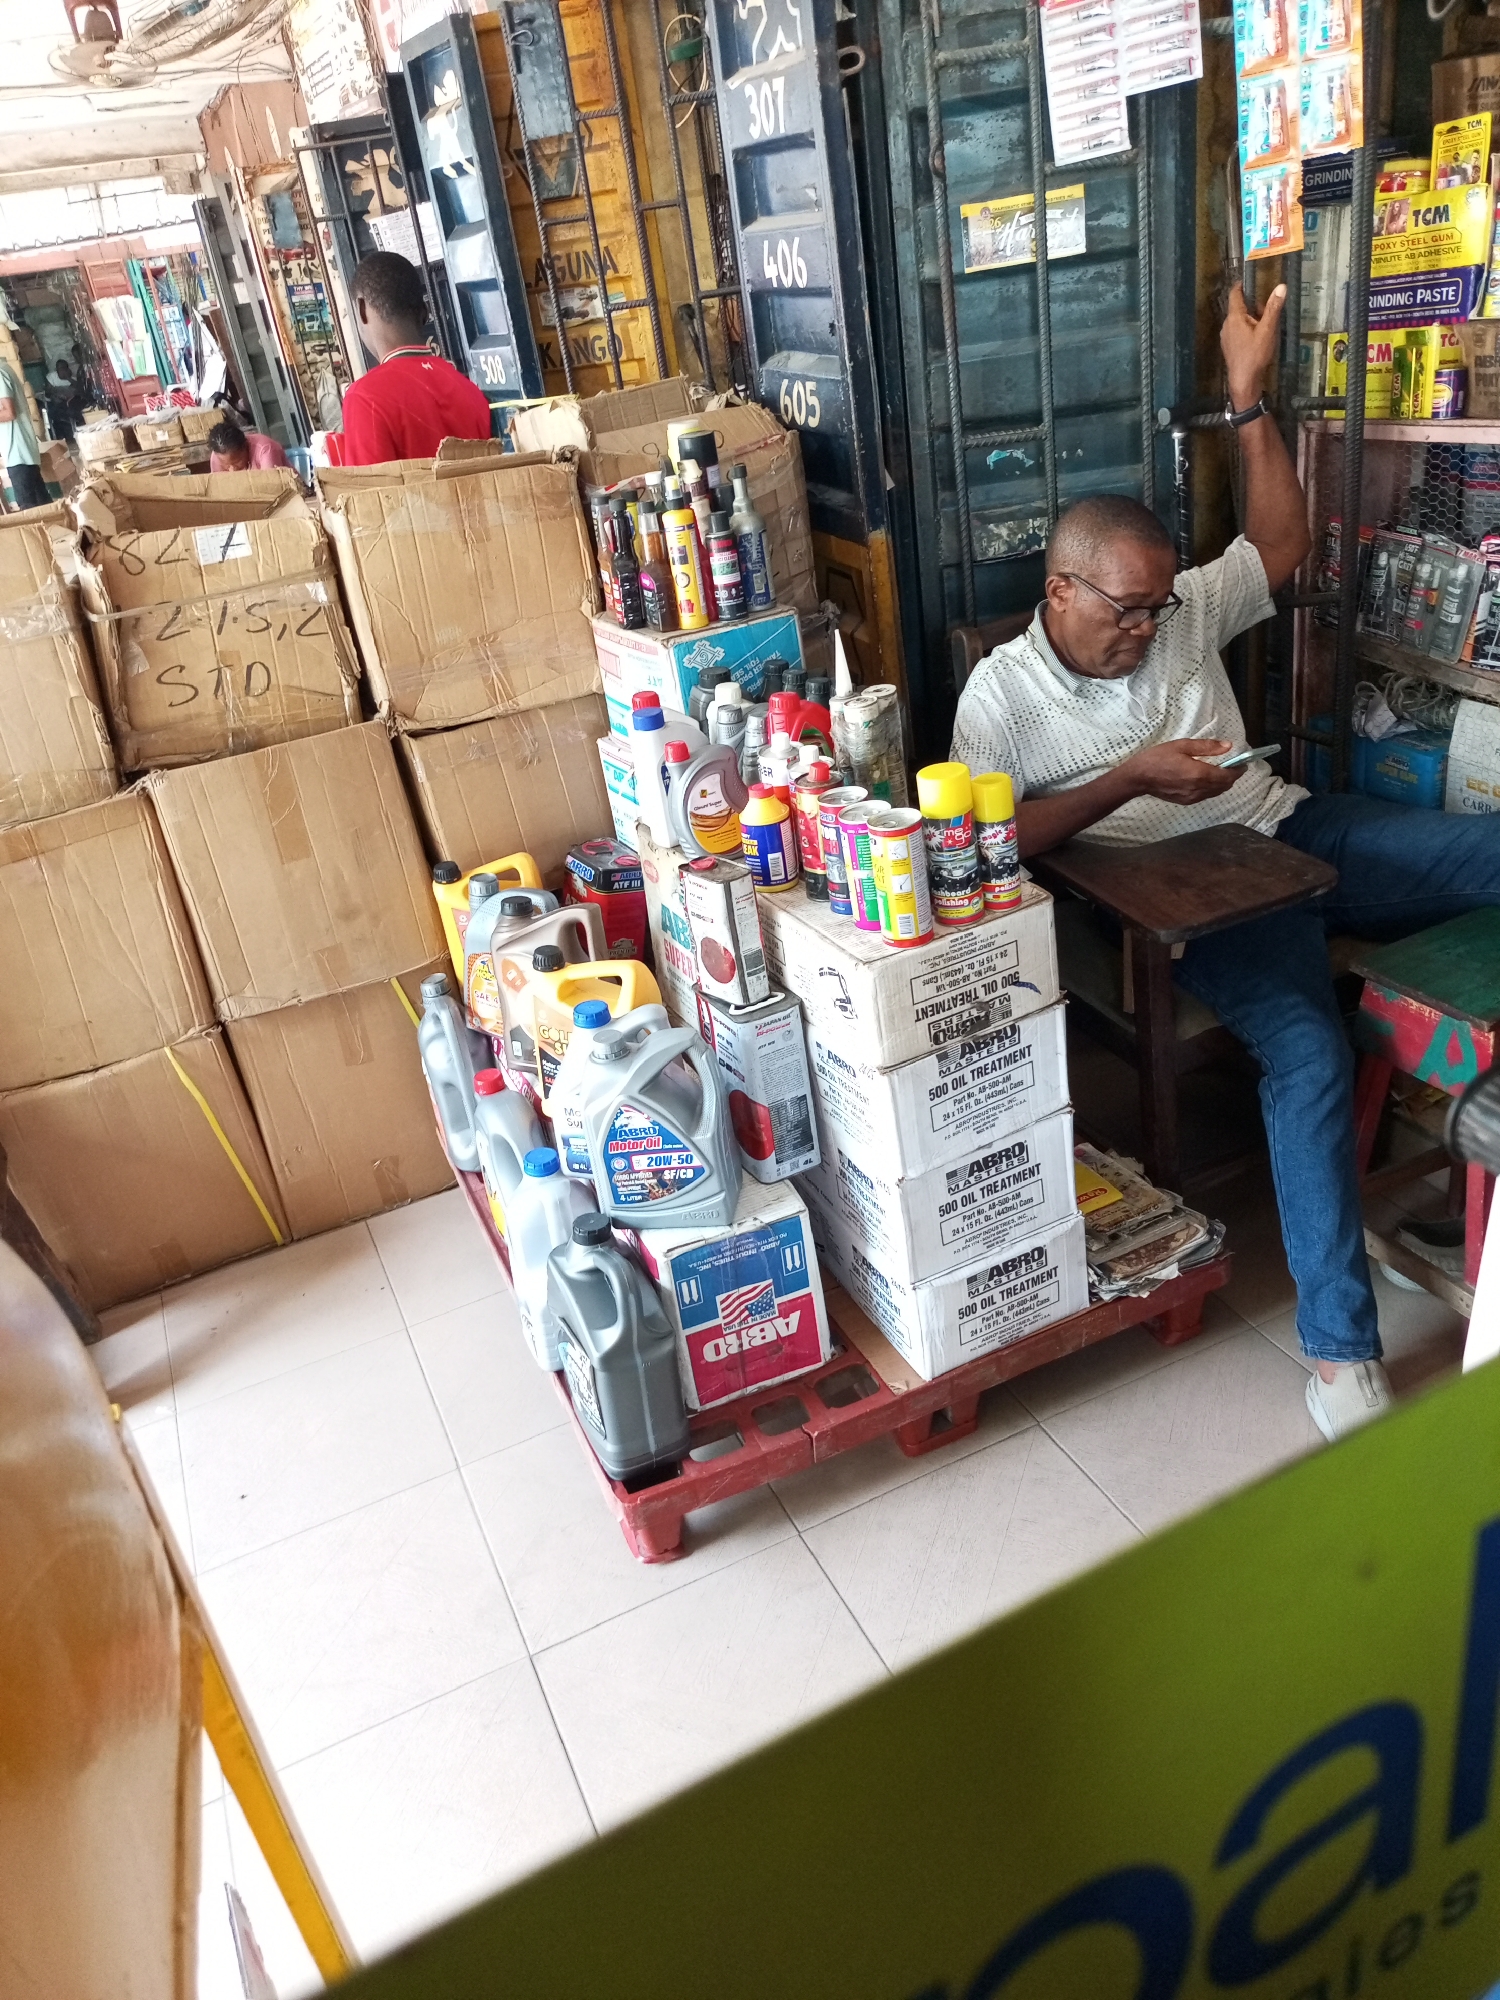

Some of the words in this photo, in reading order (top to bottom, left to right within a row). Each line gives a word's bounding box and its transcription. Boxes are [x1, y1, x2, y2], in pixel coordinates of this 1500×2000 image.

[744, 76, 785, 140] 307
[1467, 119, 1482, 129] TCM
[1305, 168, 1353, 187] GRINDIN
[1412, 204, 1451, 228] TCM
[1400, 237, 1428, 248] STEEL
[1431, 233, 1454, 243] GUM
[1404, 252, 1416, 260] AB
[1417, 246, 1462, 259] ADHESIVE
[525, 245, 619, 289] AGUNA
[763, 237, 808, 288] 406
[1369, 291, 1414, 309] RINDING
[1416, 286, 1457, 304] PASTE
[1366, 343, 1393, 364] CM
[479, 355, 507, 385] 508
[780, 379, 821, 428] 605
[156, 661, 272, 707] STD
[731, 665, 747, 682] SEA
[567, 858, 595, 882] ABRO
[613, 880, 630, 889] ATF
[934, 898, 970, 907] polishing
[995, 882, 1021, 893] polishin
[661, 903, 690, 950] AB
[664, 938, 695, 982] SUPER
[983, 965, 997, 978] Part
[922, 973, 938, 987] Cans
[980, 979, 999, 998] OIL
[1001, 971, 1020, 990] 500
[914, 986, 980, 1023] TREATMENT
[938, 1037, 1018, 1077] MASTERS
[959, 1022, 1019, 1060] ABRO
[929, 1083, 948, 1101] 500
[951, 1074, 968, 1091] OIL
[970, 1044, 1033, 1081] TREATMENT
[943, 1112, 951, 1122] 24
[957, 1106, 964, 1116] 15
[1009, 1079, 1024, 1091] Cans
[953, 1094, 966, 1107] Part
[978, 1074, 1012, 1095] AB-500-AM
[609, 1140, 645, 1154] Motor
[645, 1136, 662, 1150] Oil
[617, 1125, 659, 1140] ABRO
[646, 1154, 694, 1168] 20W-50
[947, 1155, 1026, 1194] MASTERS
[967, 1141, 1026, 1178] ABRO
[938, 1200, 958, 1218] 500
[960, 1190, 977, 1207] OIL
[980, 1163, 1042, 1198] TREATMENT
[962, 1210, 976, 1222] Part
[977, 1205, 987, 1215] No.
[988, 1191, 1021, 1212] AB-500-AM
[952, 1226, 960, 1236] 24
[966, 1221, 973, 1230] 15
[974, 1217, 983, 1227] Fl.
[984, 1213, 993, 1223] Oz.
[1019, 1196, 1034, 1208] Cans
[968, 1260, 1045, 1298] MASTERS
[987, 1246, 1046, 1283] ABRO
[958, 1303, 977, 1320] 500
[981, 1293, 997, 1310] OIL
[998, 1266, 1059, 1301] TREATMENT
[982, 1311, 995, 1324] Part
[1007, 1292, 1039, 1313] AB-500-AM
[984, 1322, 992, 1332] 15
[1036, 1296, 1050, 1308] Cans
[703, 1310, 801, 1363] ABRO
